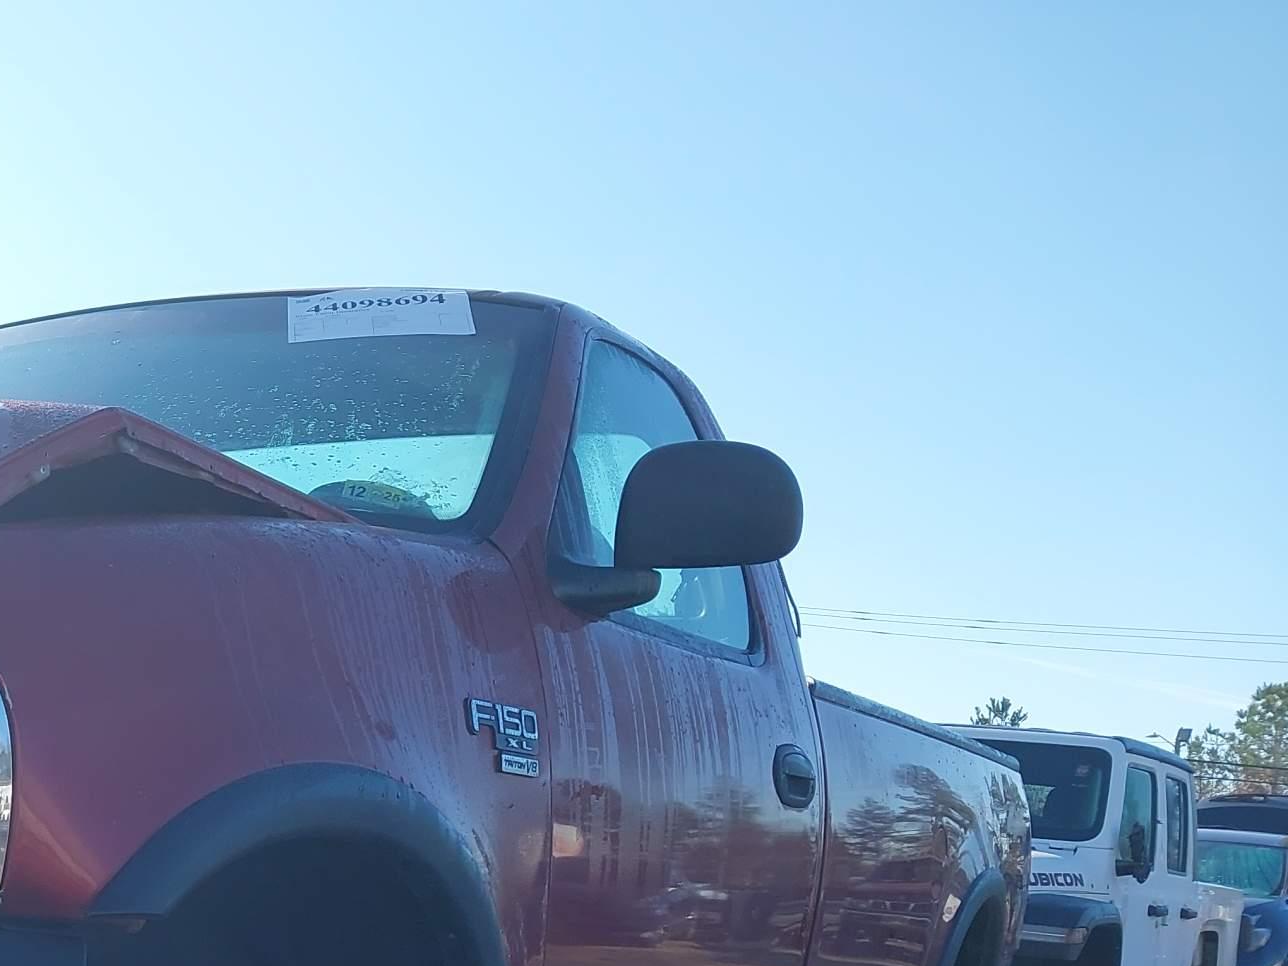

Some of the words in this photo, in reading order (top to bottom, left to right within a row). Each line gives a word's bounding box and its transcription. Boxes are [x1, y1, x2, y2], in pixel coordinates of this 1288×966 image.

[305, 293, 447, 313] 44098694
[348, 485, 367, 498] 12
[507, 737, 533, 751] XL
[503, 758, 526, 770] TRITON
[526, 759, 538, 775] V8
[1027, 872, 1085, 887] UBICON
